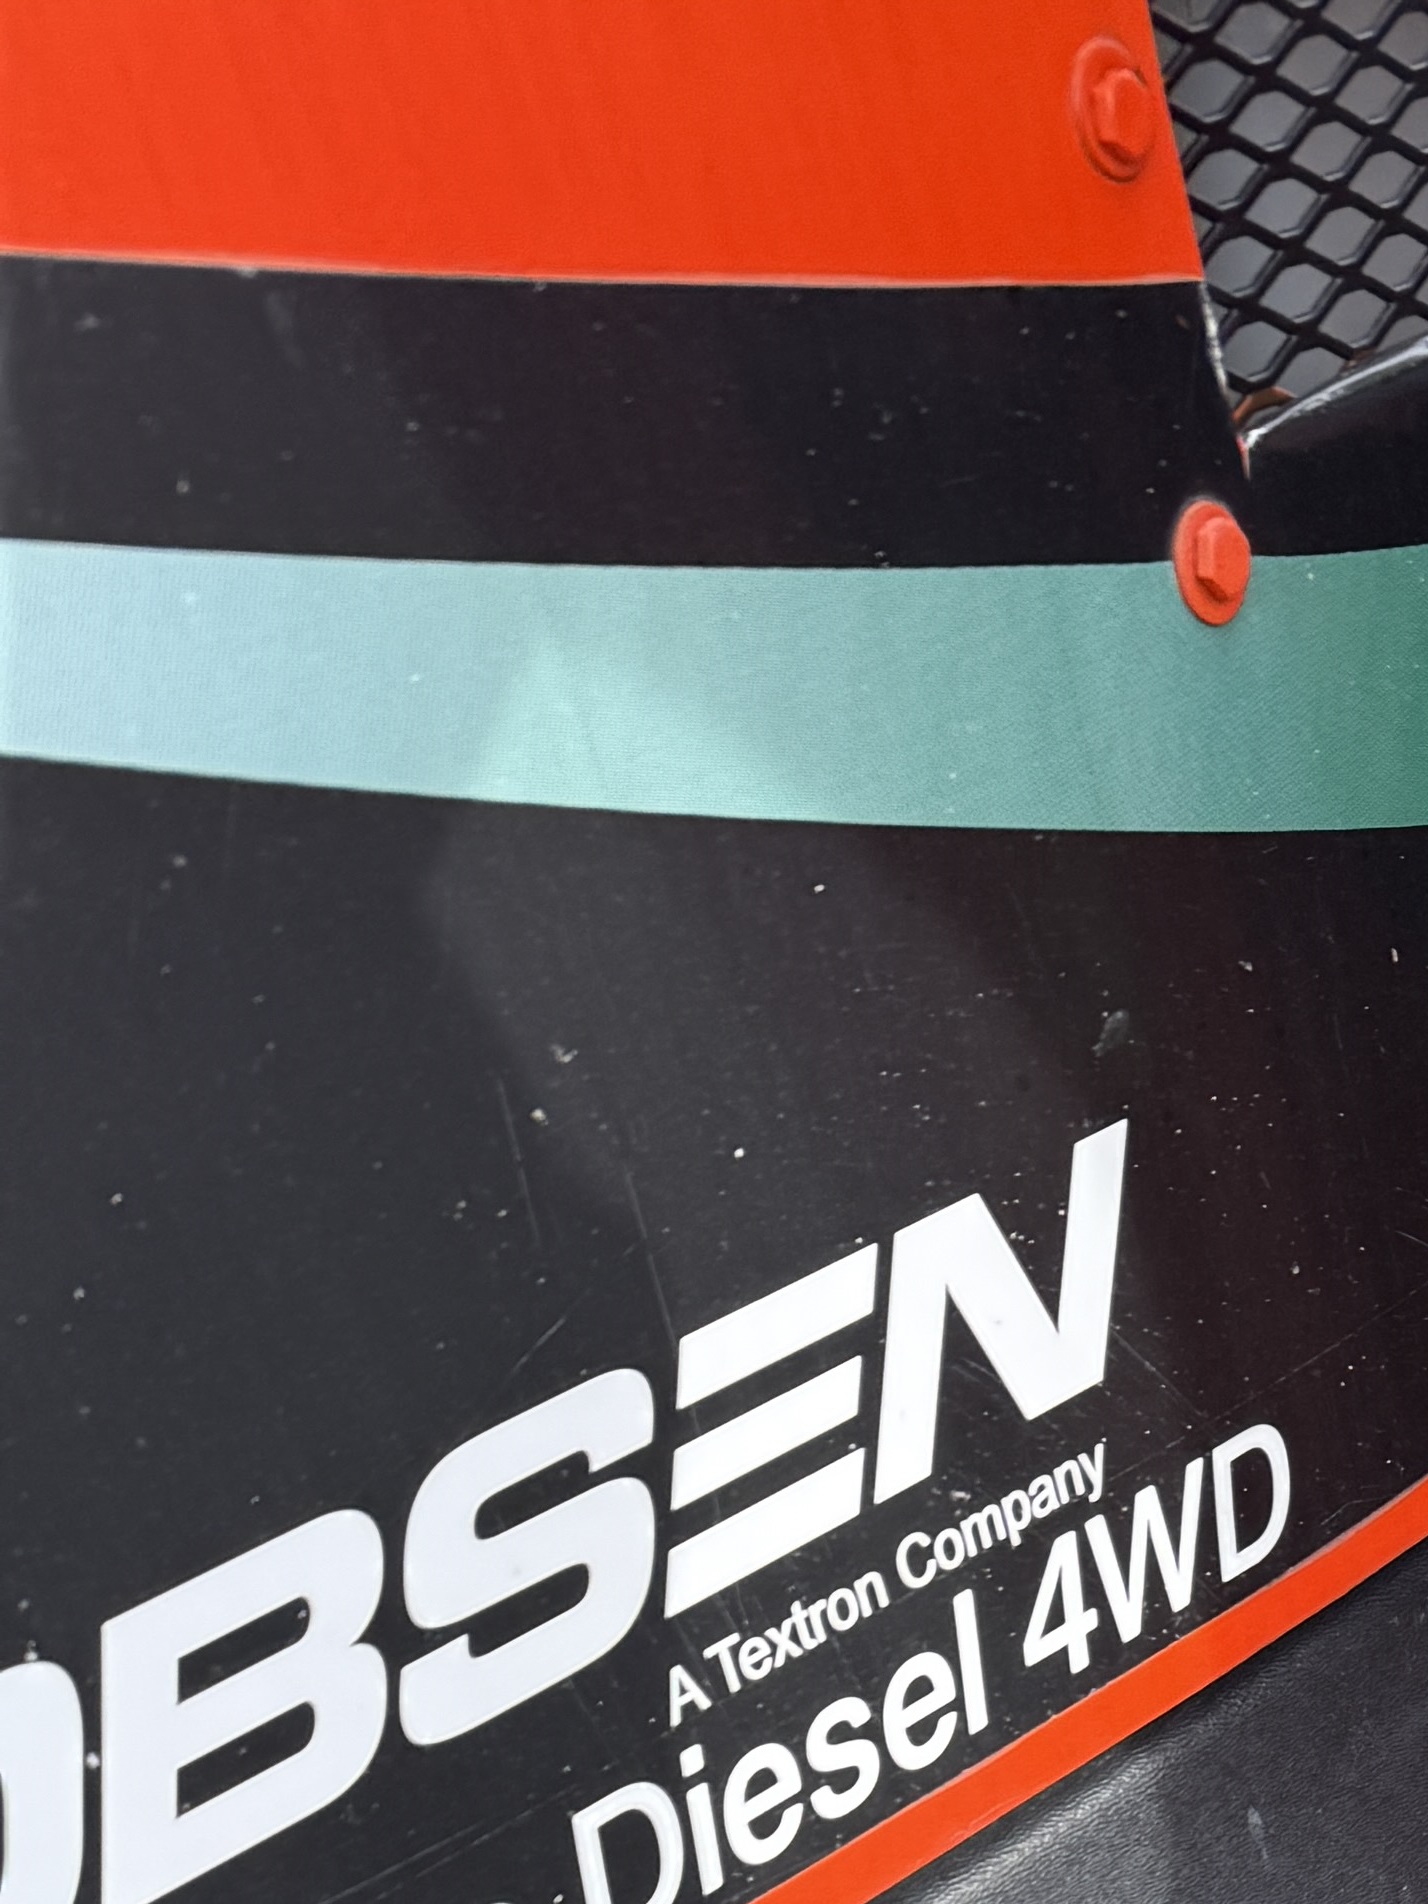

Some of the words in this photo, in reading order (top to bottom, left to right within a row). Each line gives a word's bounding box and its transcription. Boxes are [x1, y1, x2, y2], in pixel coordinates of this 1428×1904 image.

[669, 1665, 712, 1728] A
[703, 1571, 890, 1694] Textron
[895, 1442, 1106, 1590] Company
[1021, 1422, 1293, 1676] 4WD
